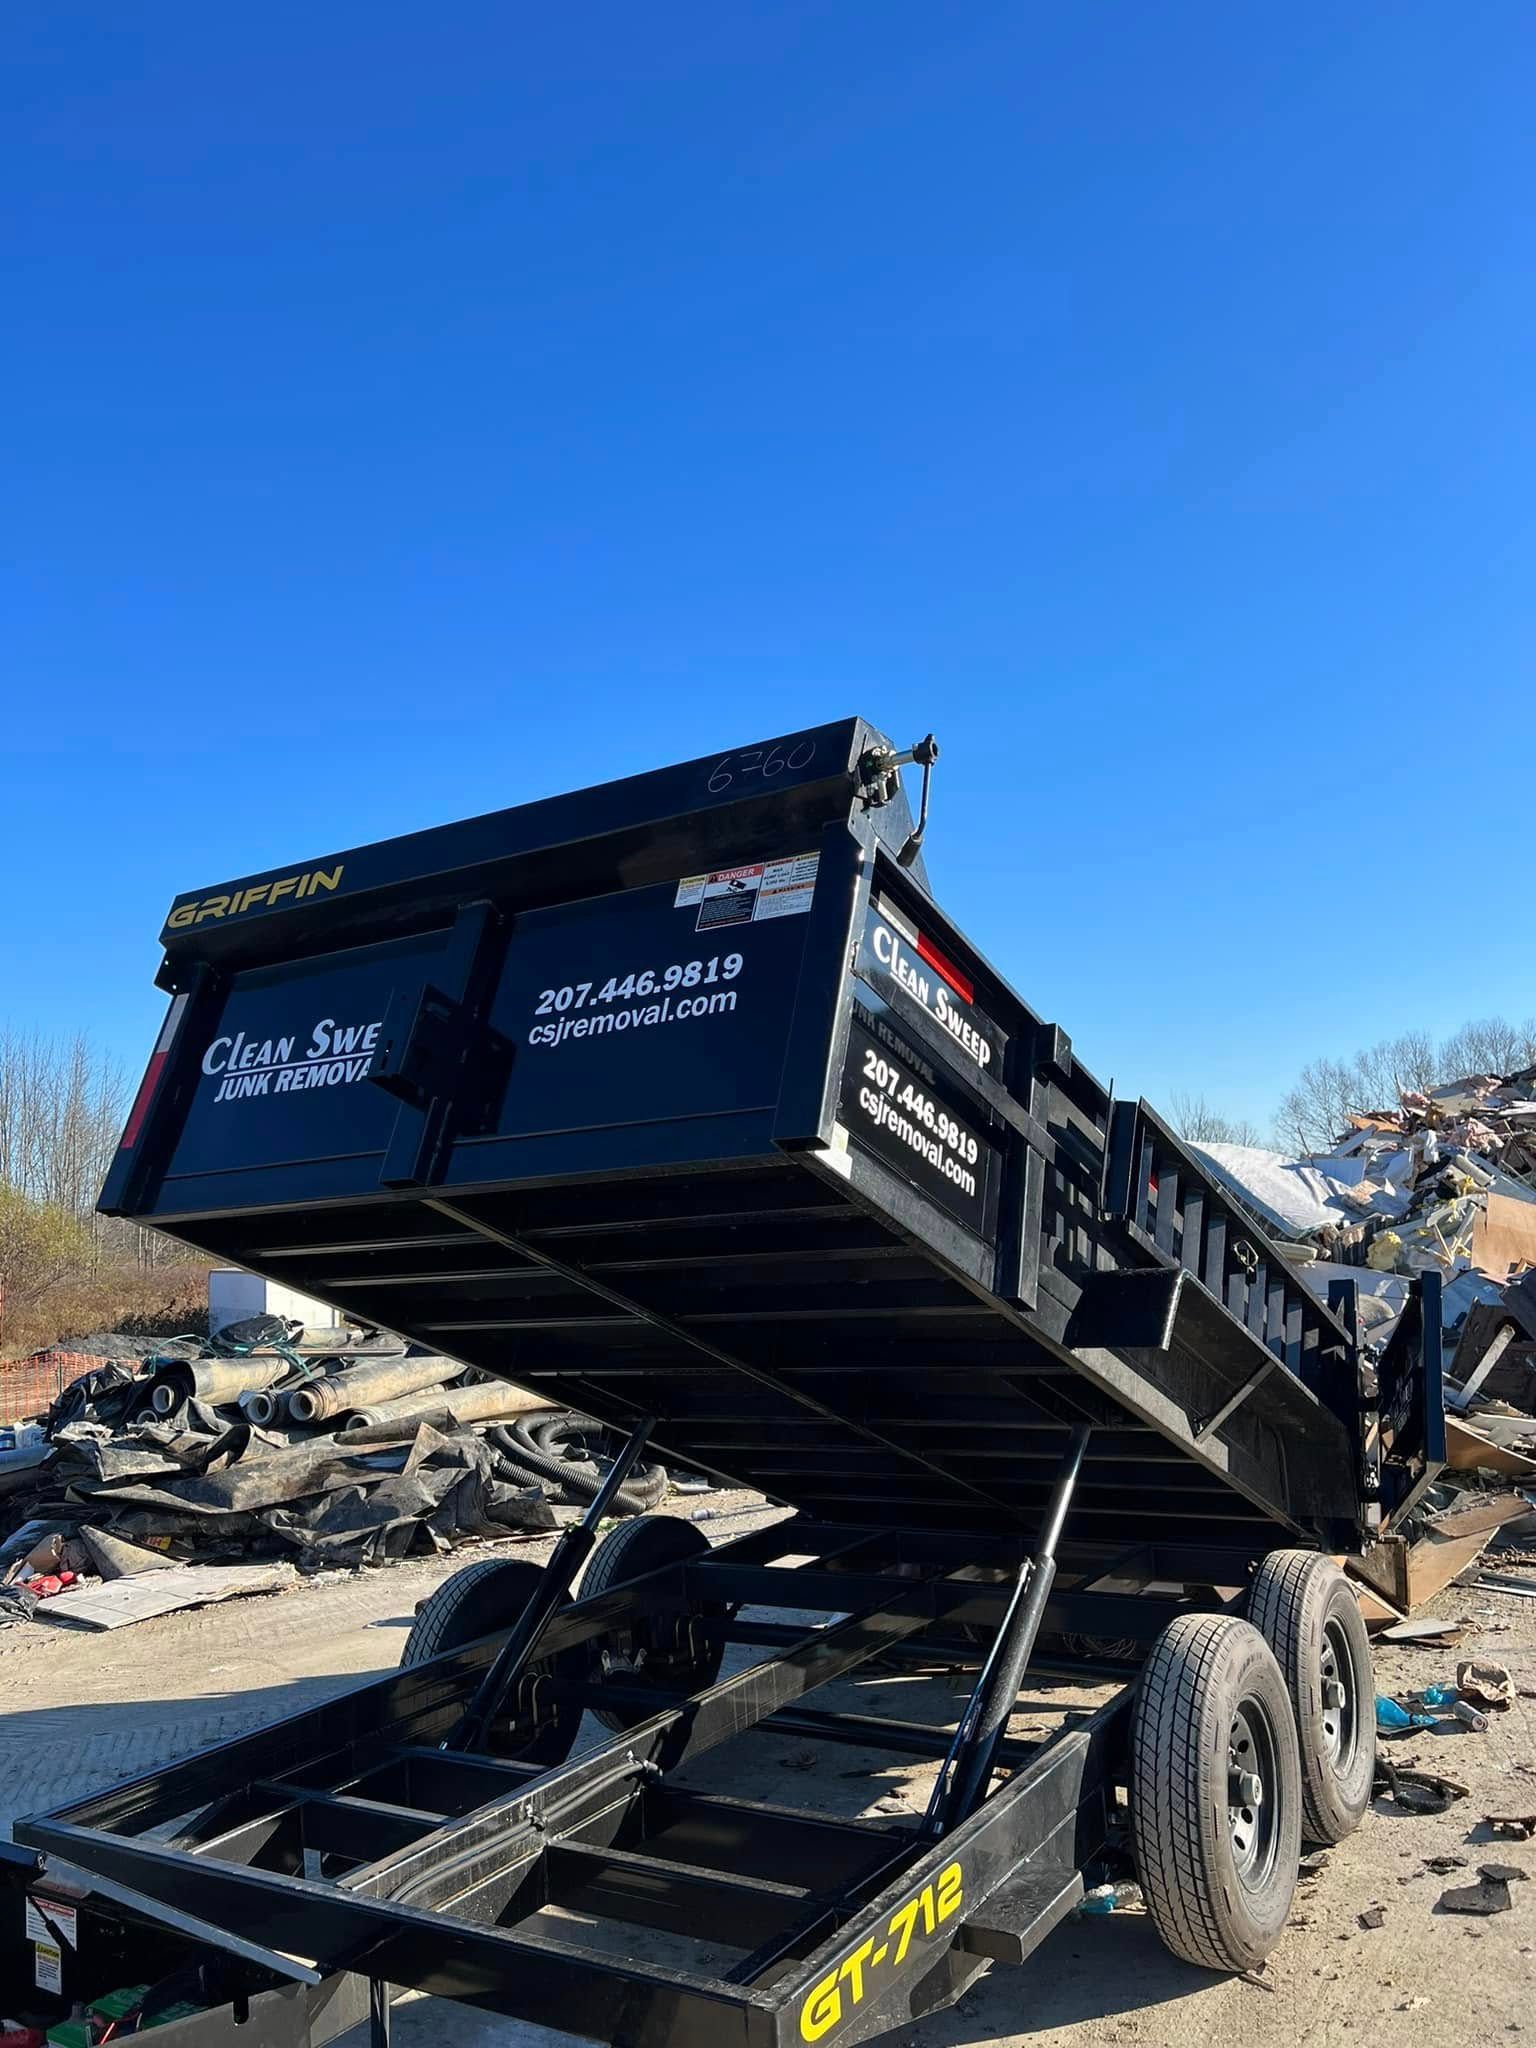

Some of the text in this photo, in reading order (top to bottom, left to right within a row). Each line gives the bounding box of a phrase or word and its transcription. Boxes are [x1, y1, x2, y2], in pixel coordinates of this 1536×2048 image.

[167, 865, 344, 929] GRIFFIN
[718, 867, 755, 882] DANGER
[534, 952, 744, 1015] 207.446.9819
[306, 1018, 383, 1058] SWE
[528, 988, 738, 1046] csjremoval.com
[214, 1057, 373, 1103] JUNK REMOVA
[878, 1021, 937, 1086] REMOVAL
[863, 1048, 979, 1166] 207.446.9819
[859, 1085, 976, 1197] csjremoval.com
[800, 1862, 964, 2043] GT-712
